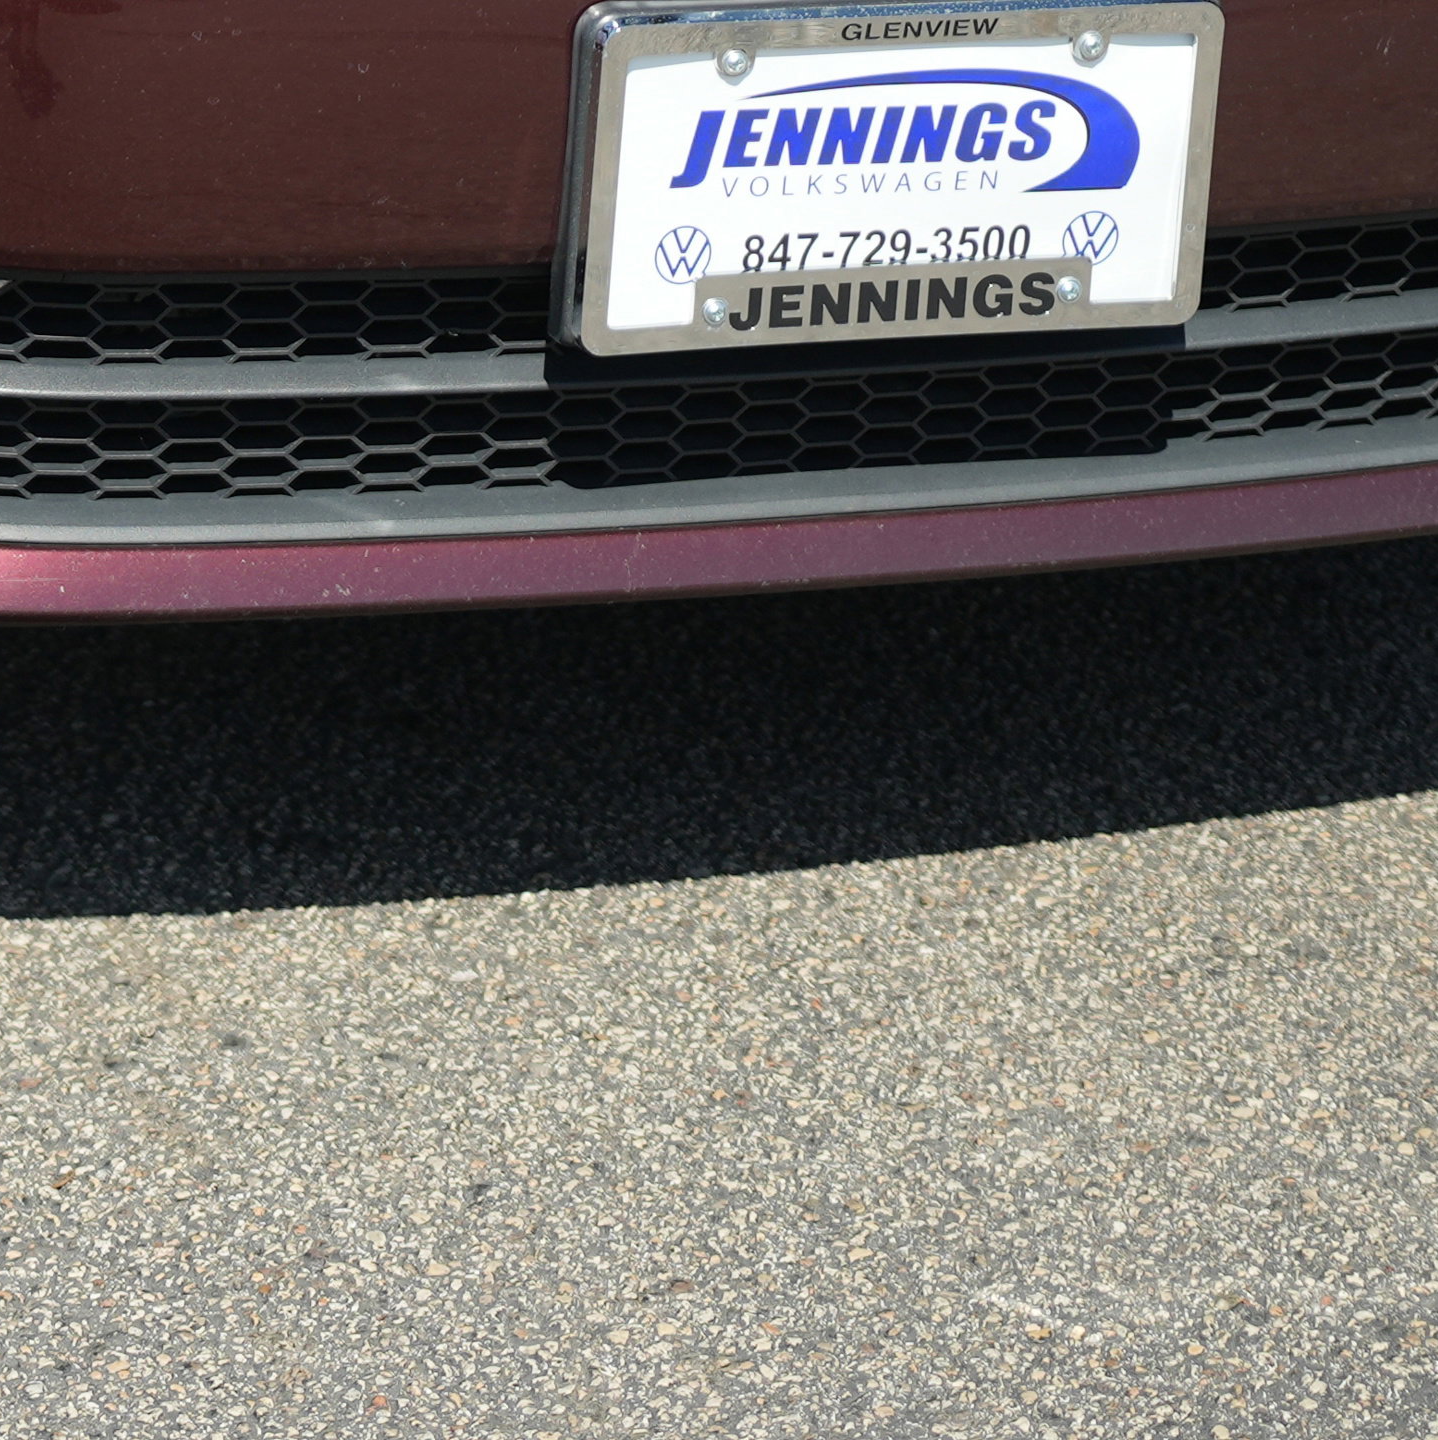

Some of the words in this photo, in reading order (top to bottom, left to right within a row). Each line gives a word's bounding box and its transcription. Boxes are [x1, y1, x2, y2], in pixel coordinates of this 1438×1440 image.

[840, 17, 999, 41] GLENVIEW
[669, 99, 1056, 189] JENNINGS
[722, 170, 999, 197] VOLKSWAGEN
[742, 224, 1031, 272] 847-729-3500
[728, 271, 1056, 332] JENNINGS
